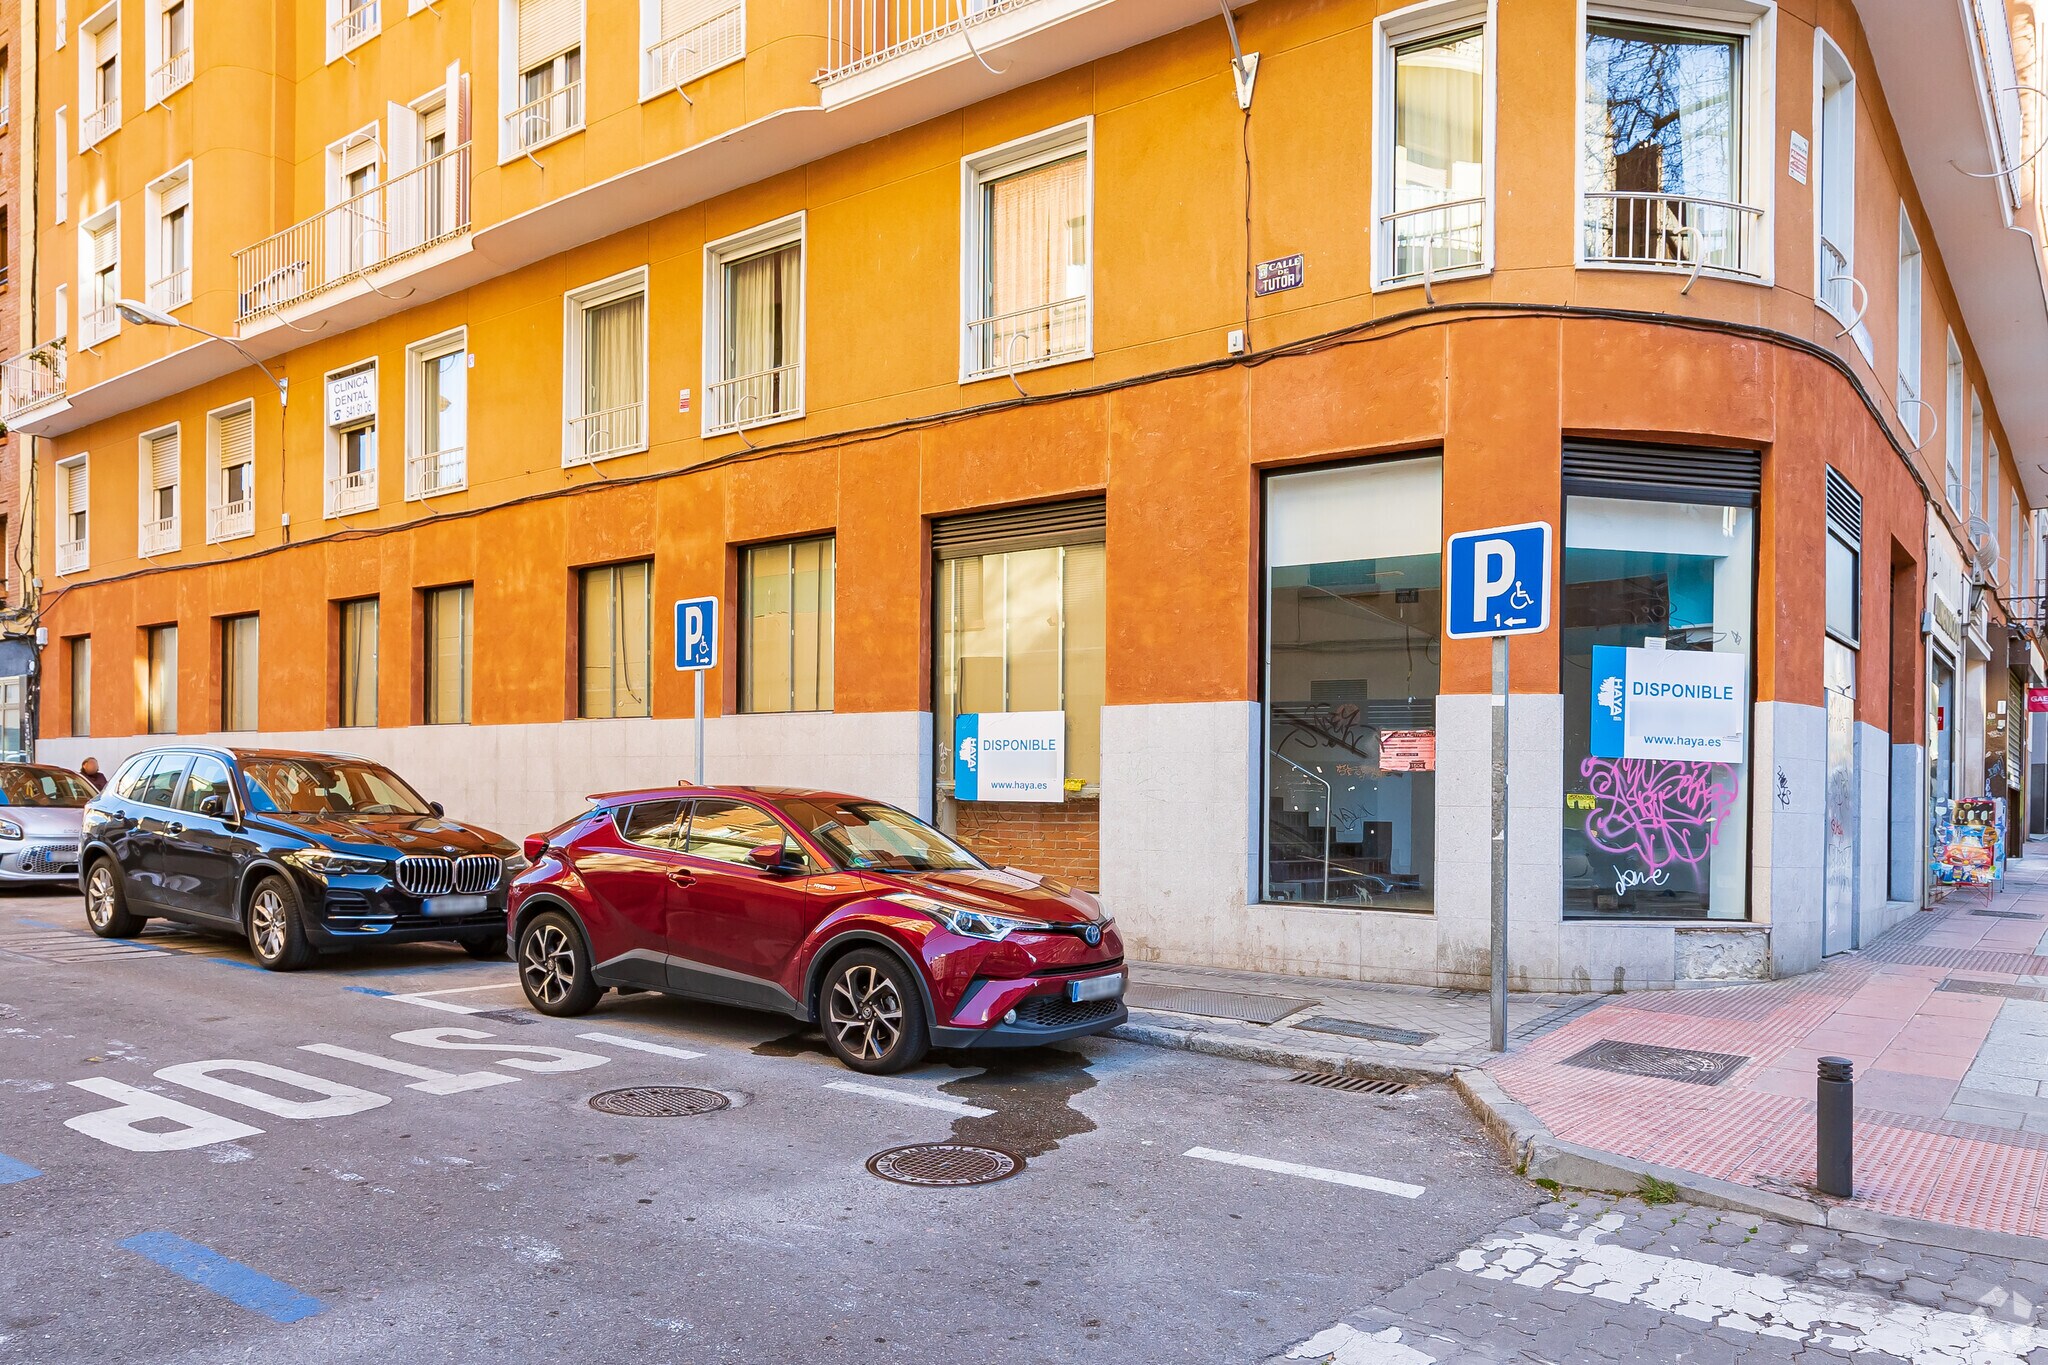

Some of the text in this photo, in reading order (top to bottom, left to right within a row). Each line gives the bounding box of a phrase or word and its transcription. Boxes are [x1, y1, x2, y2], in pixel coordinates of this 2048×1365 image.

[1269, 257, 1301, 271] CALLE
[1277, 268, 1290, 276] DE
[1263, 273, 1295, 292] TUTOR
[333, 376, 369, 394] CLINICA
[335, 389, 369, 407] DENTAL
[1473, 539, 1516, 622] P
[1494, 613, 1501, 628] 1
[685, 606, 703, 661] P
[695, 653, 699, 663] 1
[1613, 678, 1623, 716] HAYA
[1633, 681, 1734, 700] DISPONIBLE
[983, 739, 1056, 751] DISPONIBLE
[1643, 735, 1722, 748] www.haya.es
[969, 738, 977, 769] HAYA
[990, 780, 1048, 791] www.haya.es
[63, 1027, 612, 1152] STOP
